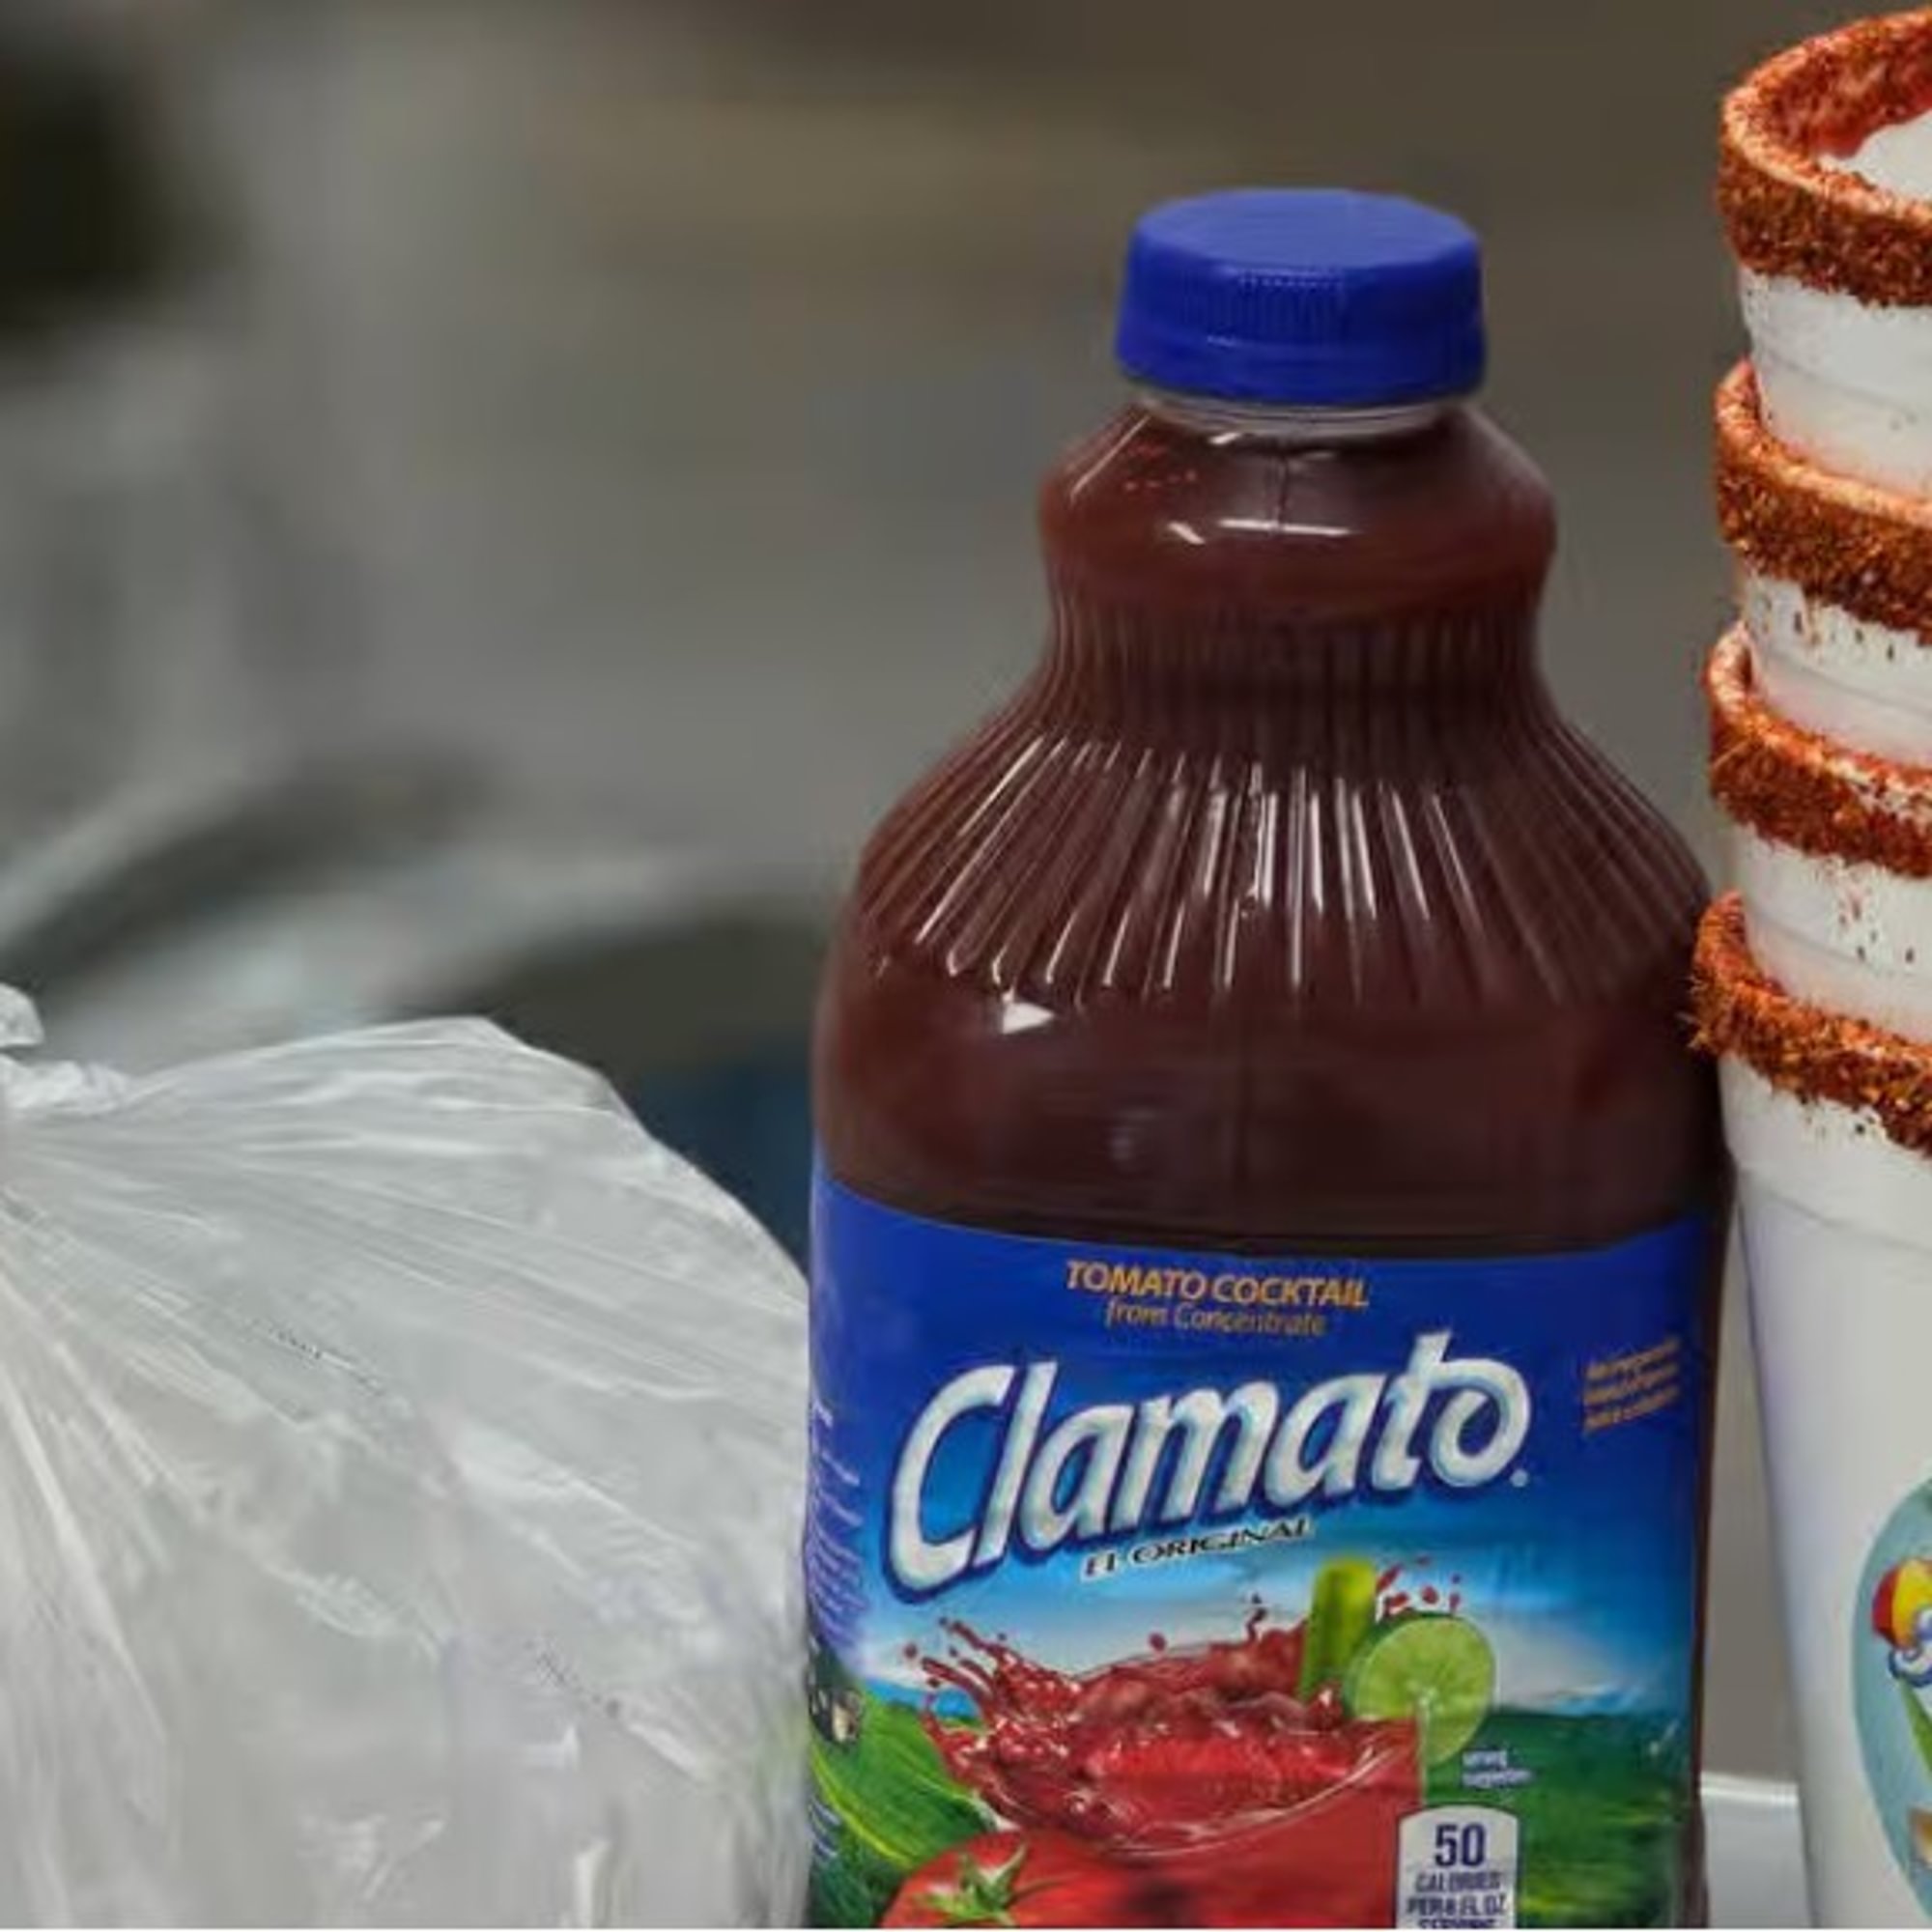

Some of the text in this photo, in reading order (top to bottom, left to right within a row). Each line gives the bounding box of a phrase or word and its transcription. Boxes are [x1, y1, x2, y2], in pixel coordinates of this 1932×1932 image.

[1065, 1260, 1371, 1308] TOMATO COCKTAIL
[1104, 1300, 1328, 1337] from Concentrate
[891, 1331, 1531, 1593] Clamato
[1435, 1823, 1487, 1866] 50
